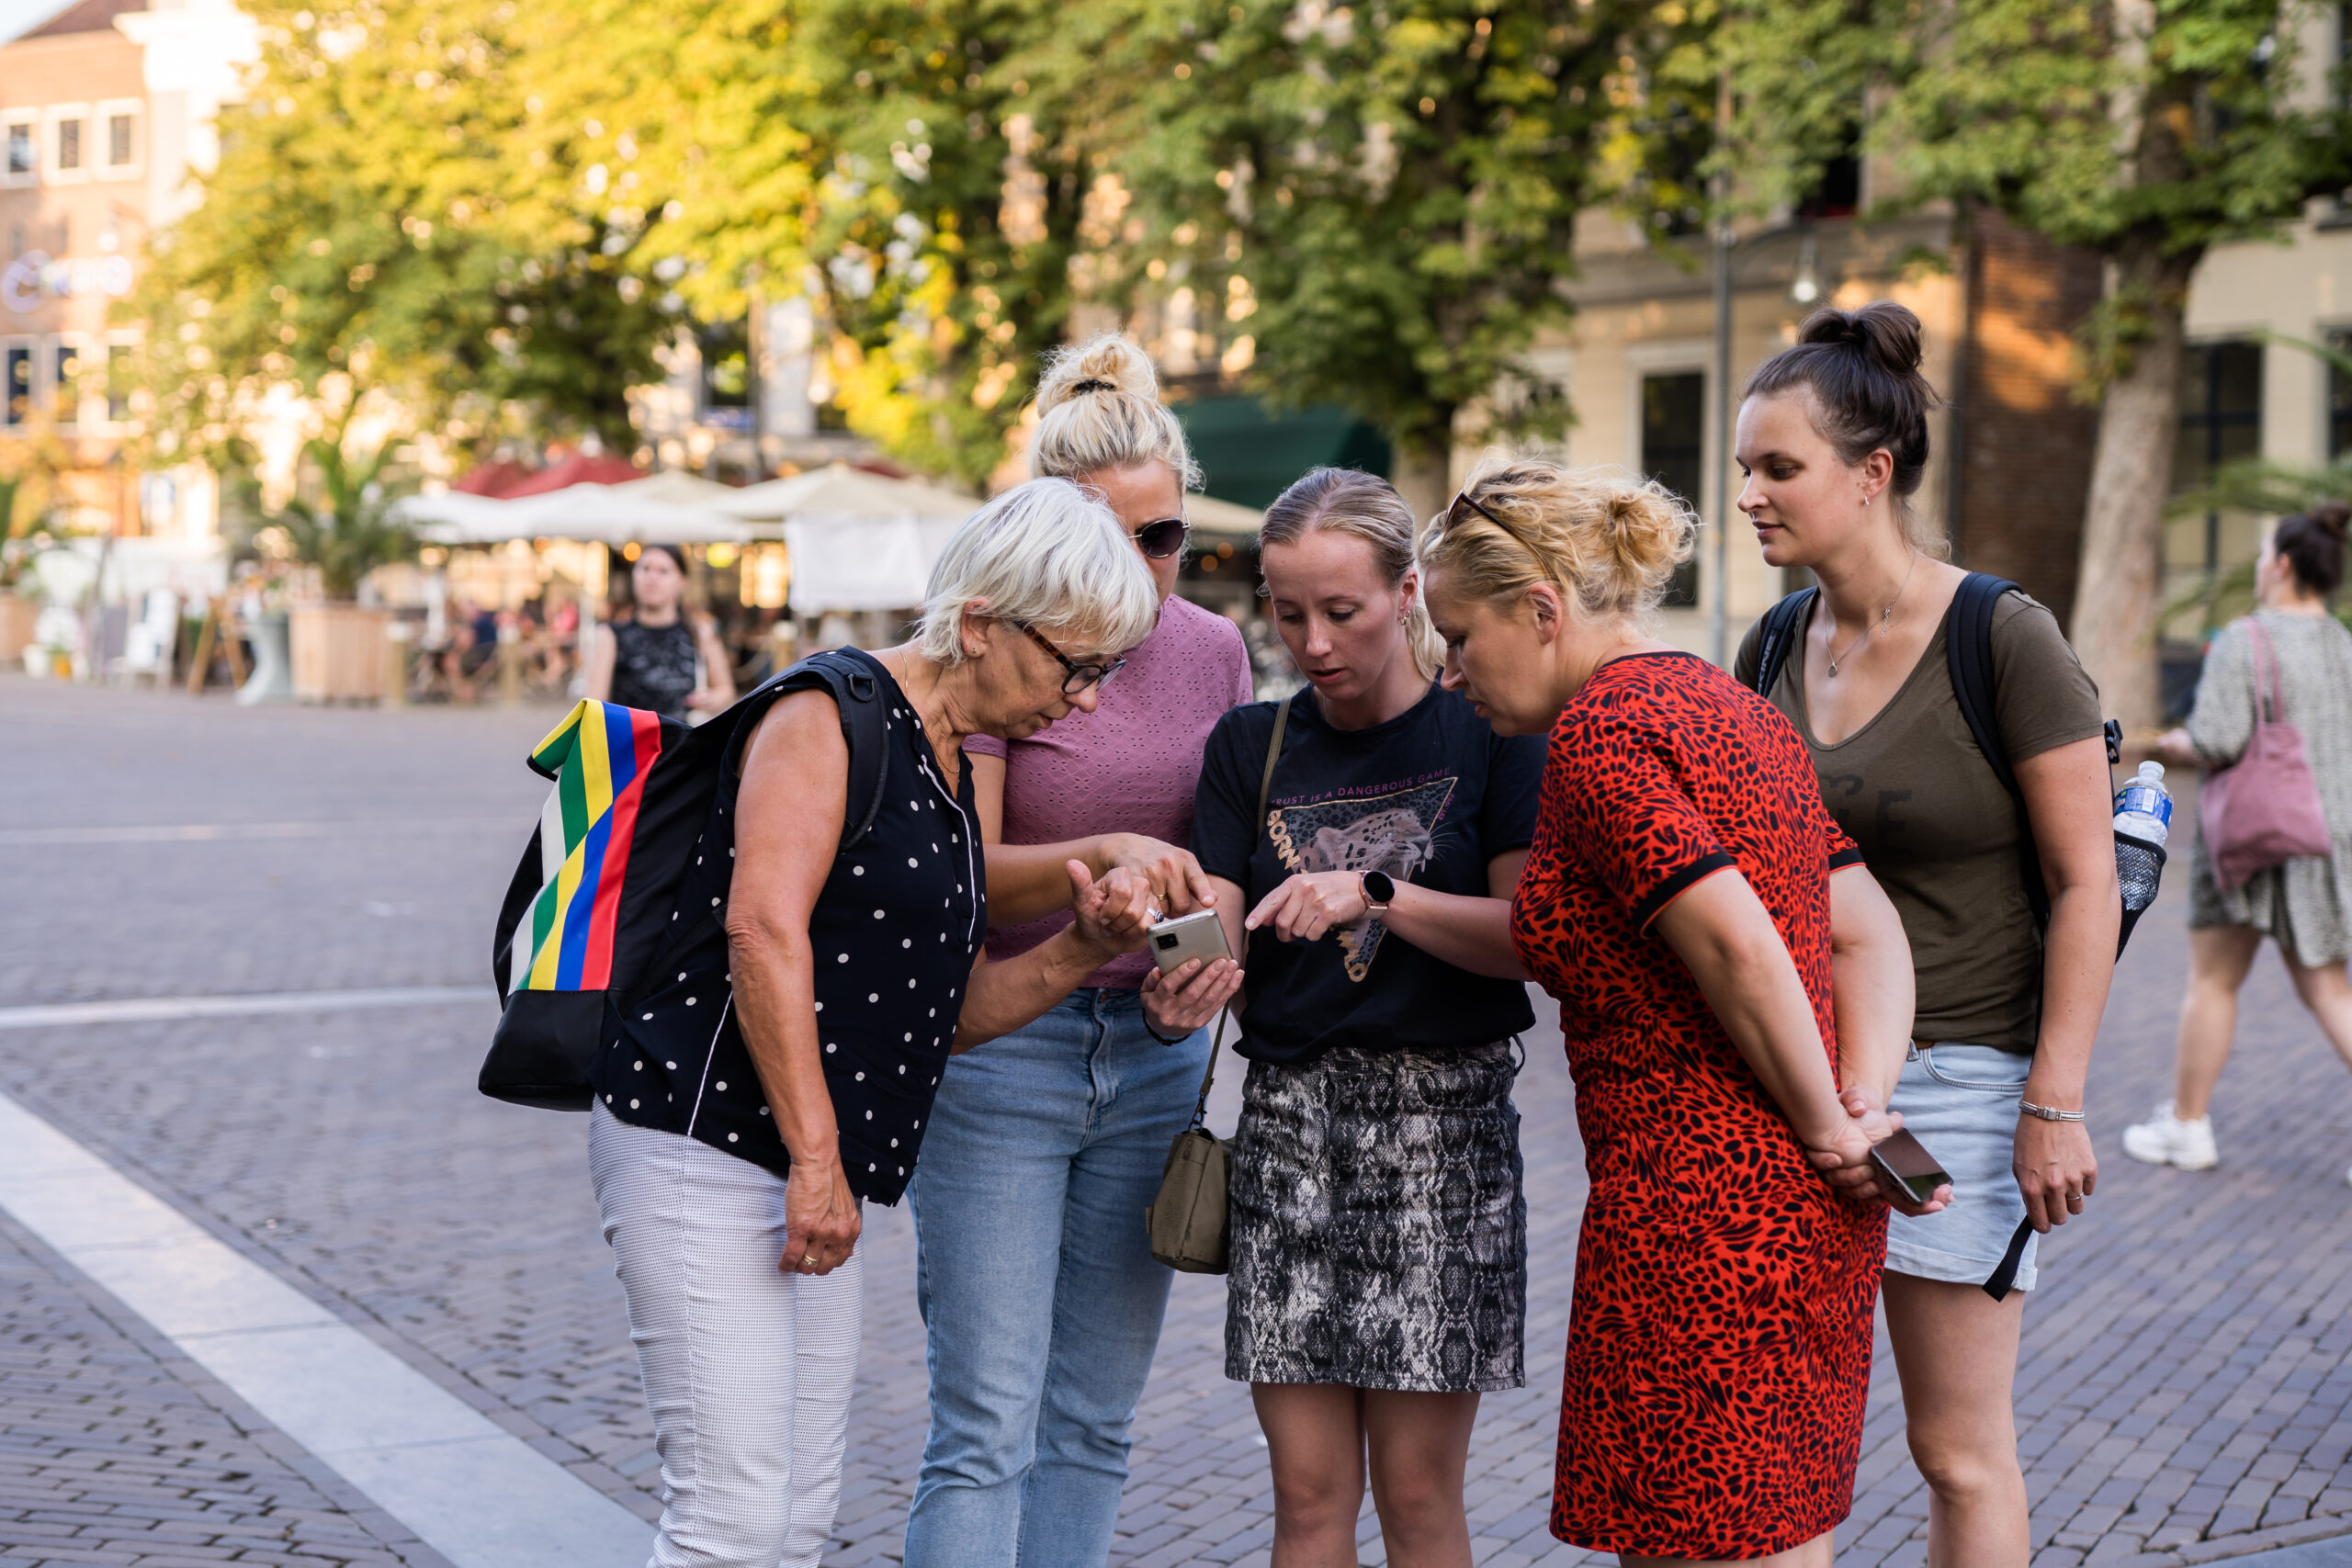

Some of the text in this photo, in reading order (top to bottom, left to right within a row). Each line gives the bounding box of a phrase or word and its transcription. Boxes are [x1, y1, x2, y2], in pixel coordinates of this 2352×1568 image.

[1310, 794, 1321, 803] IS
[1325, 791, 1333, 799] A
[1338, 777, 1413, 796] DANGEROUS
[1418, 767, 1451, 784] GAME
[1267, 809, 1301, 870] BORN
